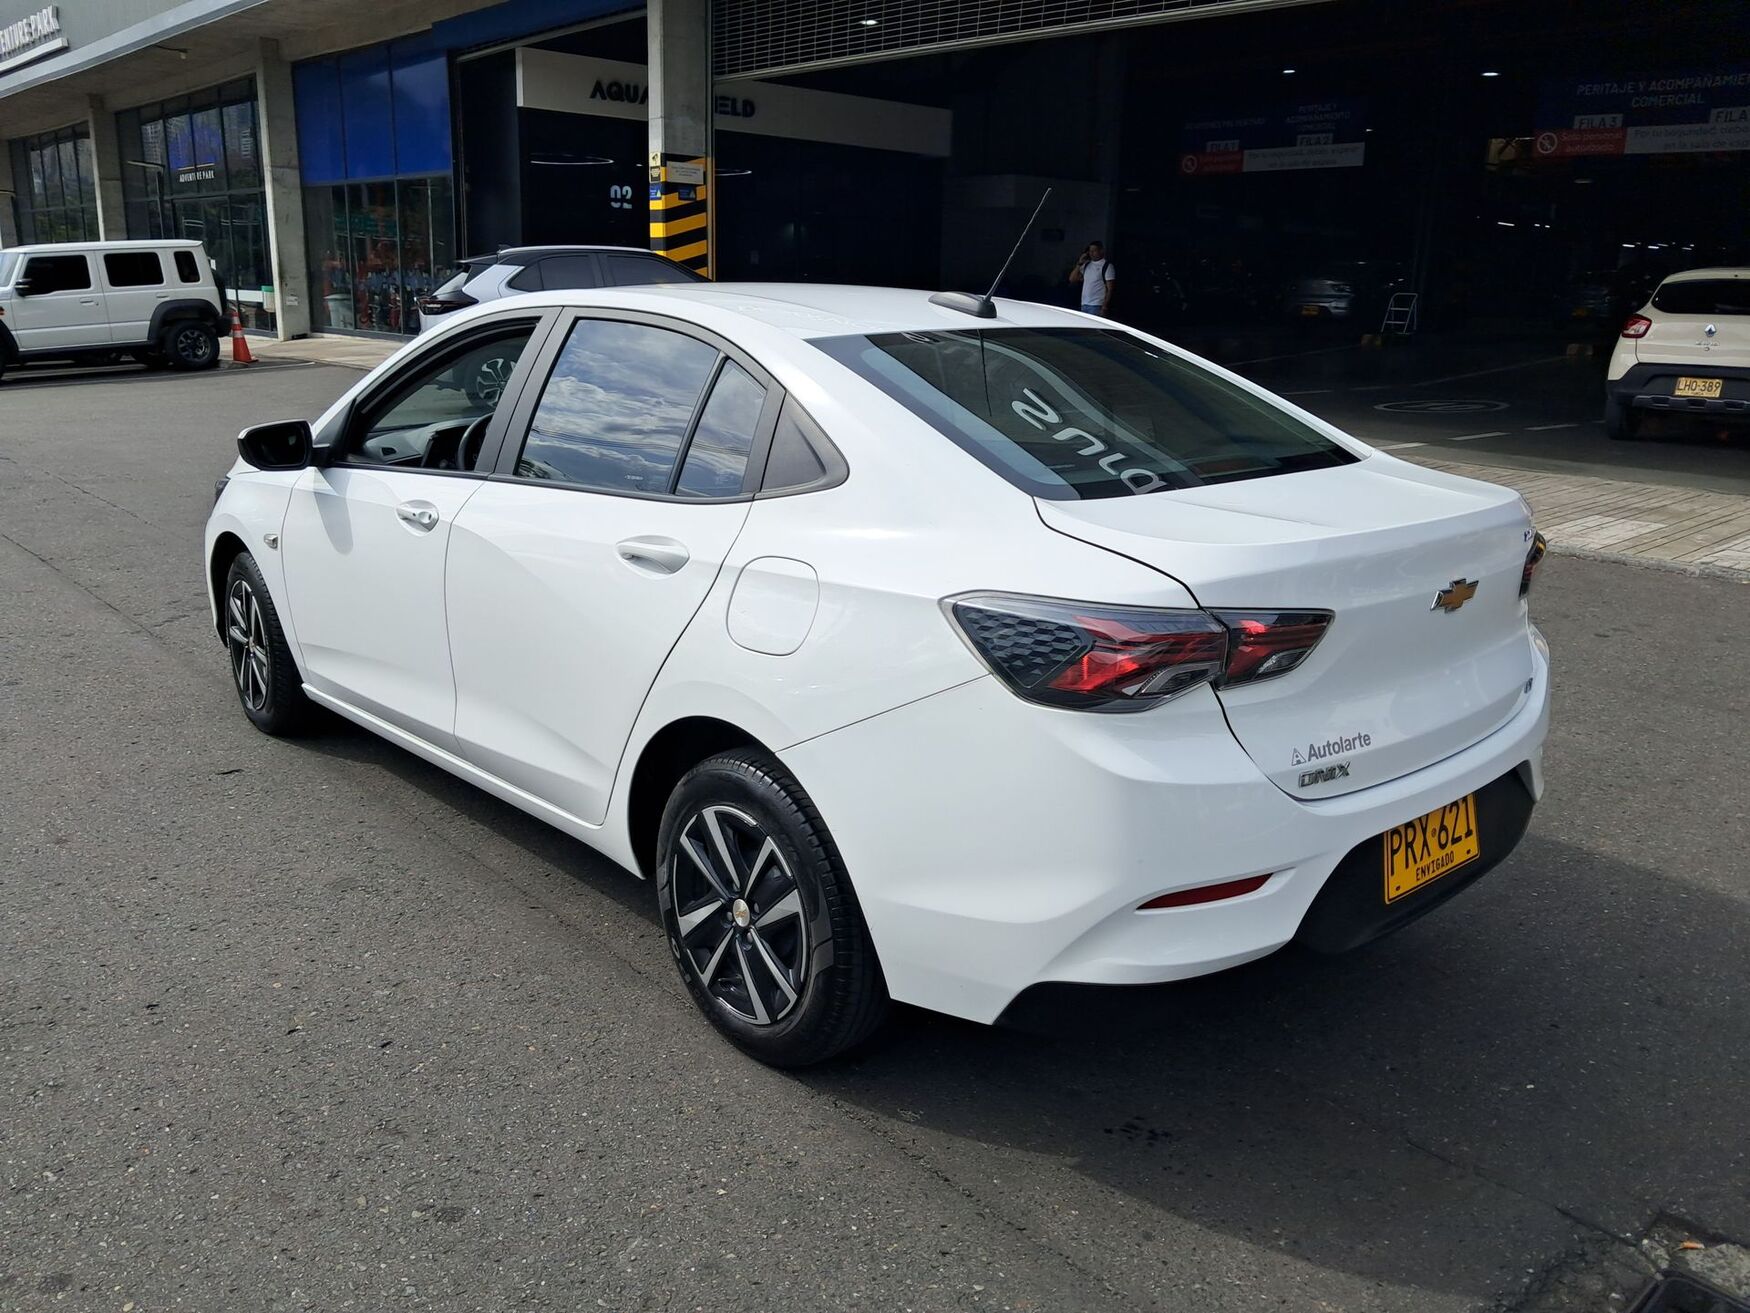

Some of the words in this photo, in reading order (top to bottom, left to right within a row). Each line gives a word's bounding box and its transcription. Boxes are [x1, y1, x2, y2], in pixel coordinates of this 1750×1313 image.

[30, 5, 60, 39] PARK
[1576, 80, 1635, 96] PERITAJE
[1631, 92, 1705, 108] COMERCIAL
[1579, 116, 1606, 128] FILA
[610, 184, 633, 210] 02
[1308, 732, 1371, 762] Autolarte
[1415, 851, 1455, 881] ENVIGADO
